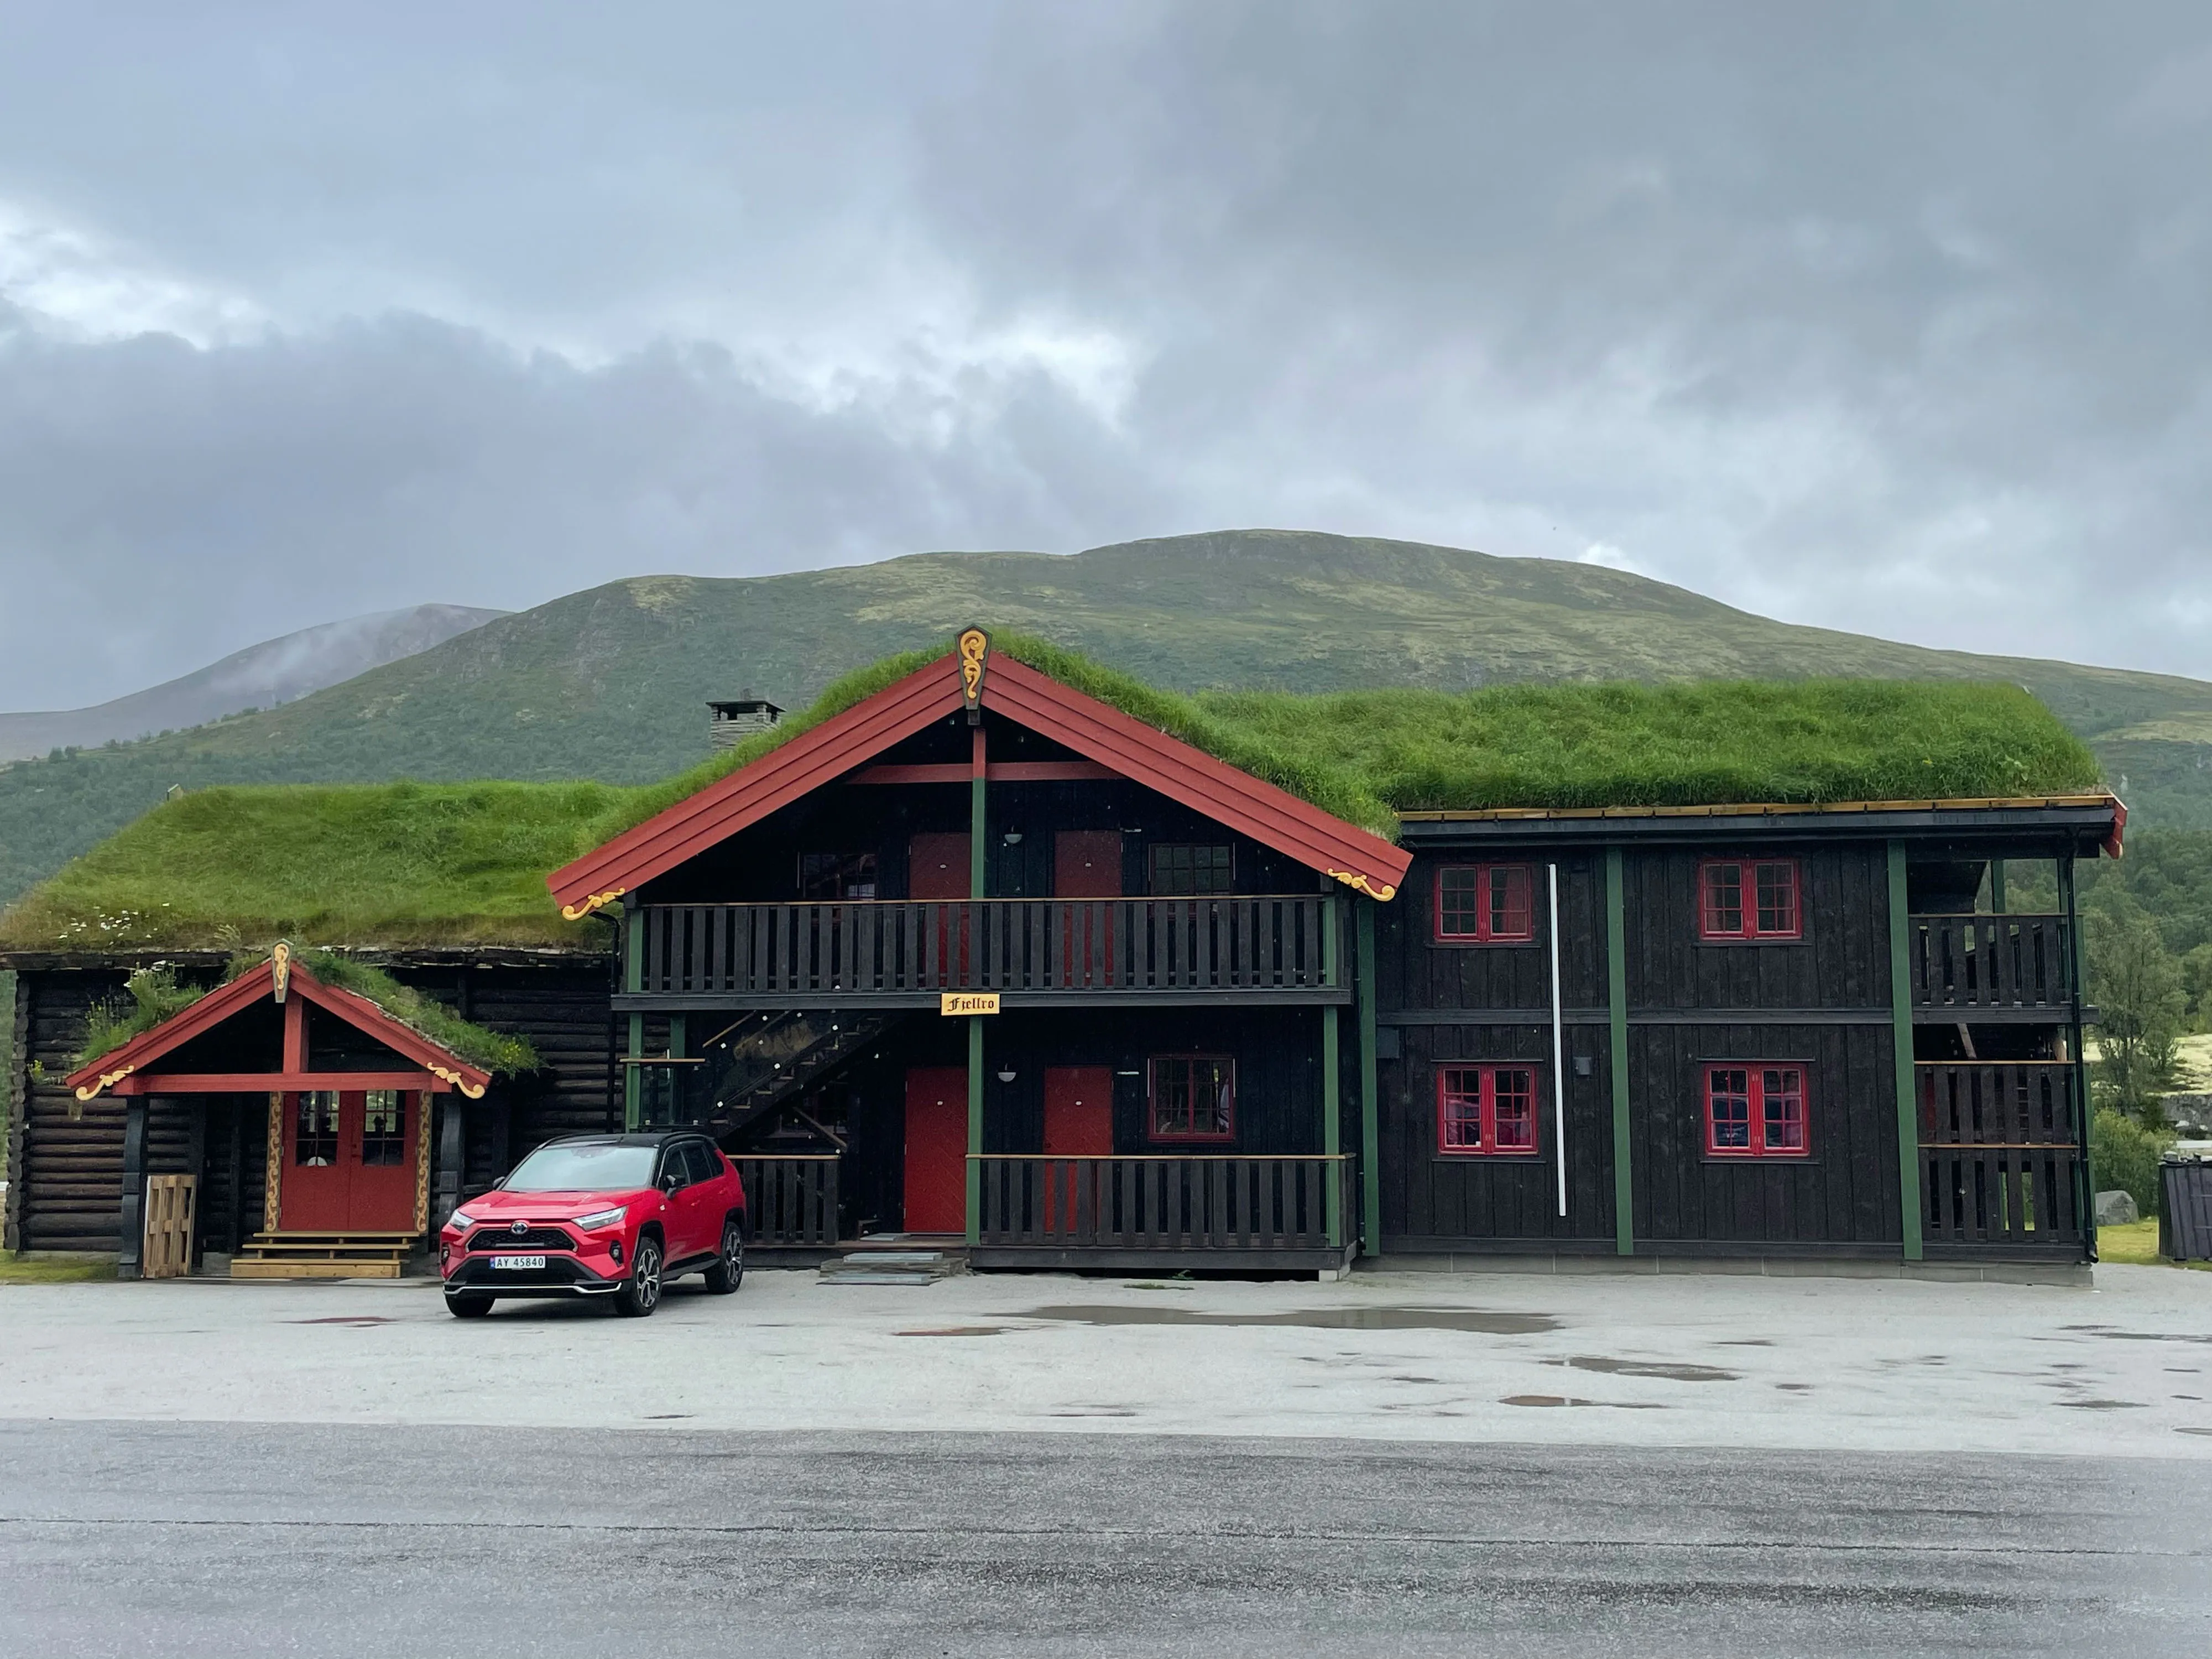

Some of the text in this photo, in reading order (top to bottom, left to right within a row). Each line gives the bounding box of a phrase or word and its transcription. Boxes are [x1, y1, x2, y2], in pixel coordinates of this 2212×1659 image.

[947, 997, 994, 1011] Fjellro
[497, 1258, 509, 1267] AY
[513, 1258, 544, 1267] 45840
